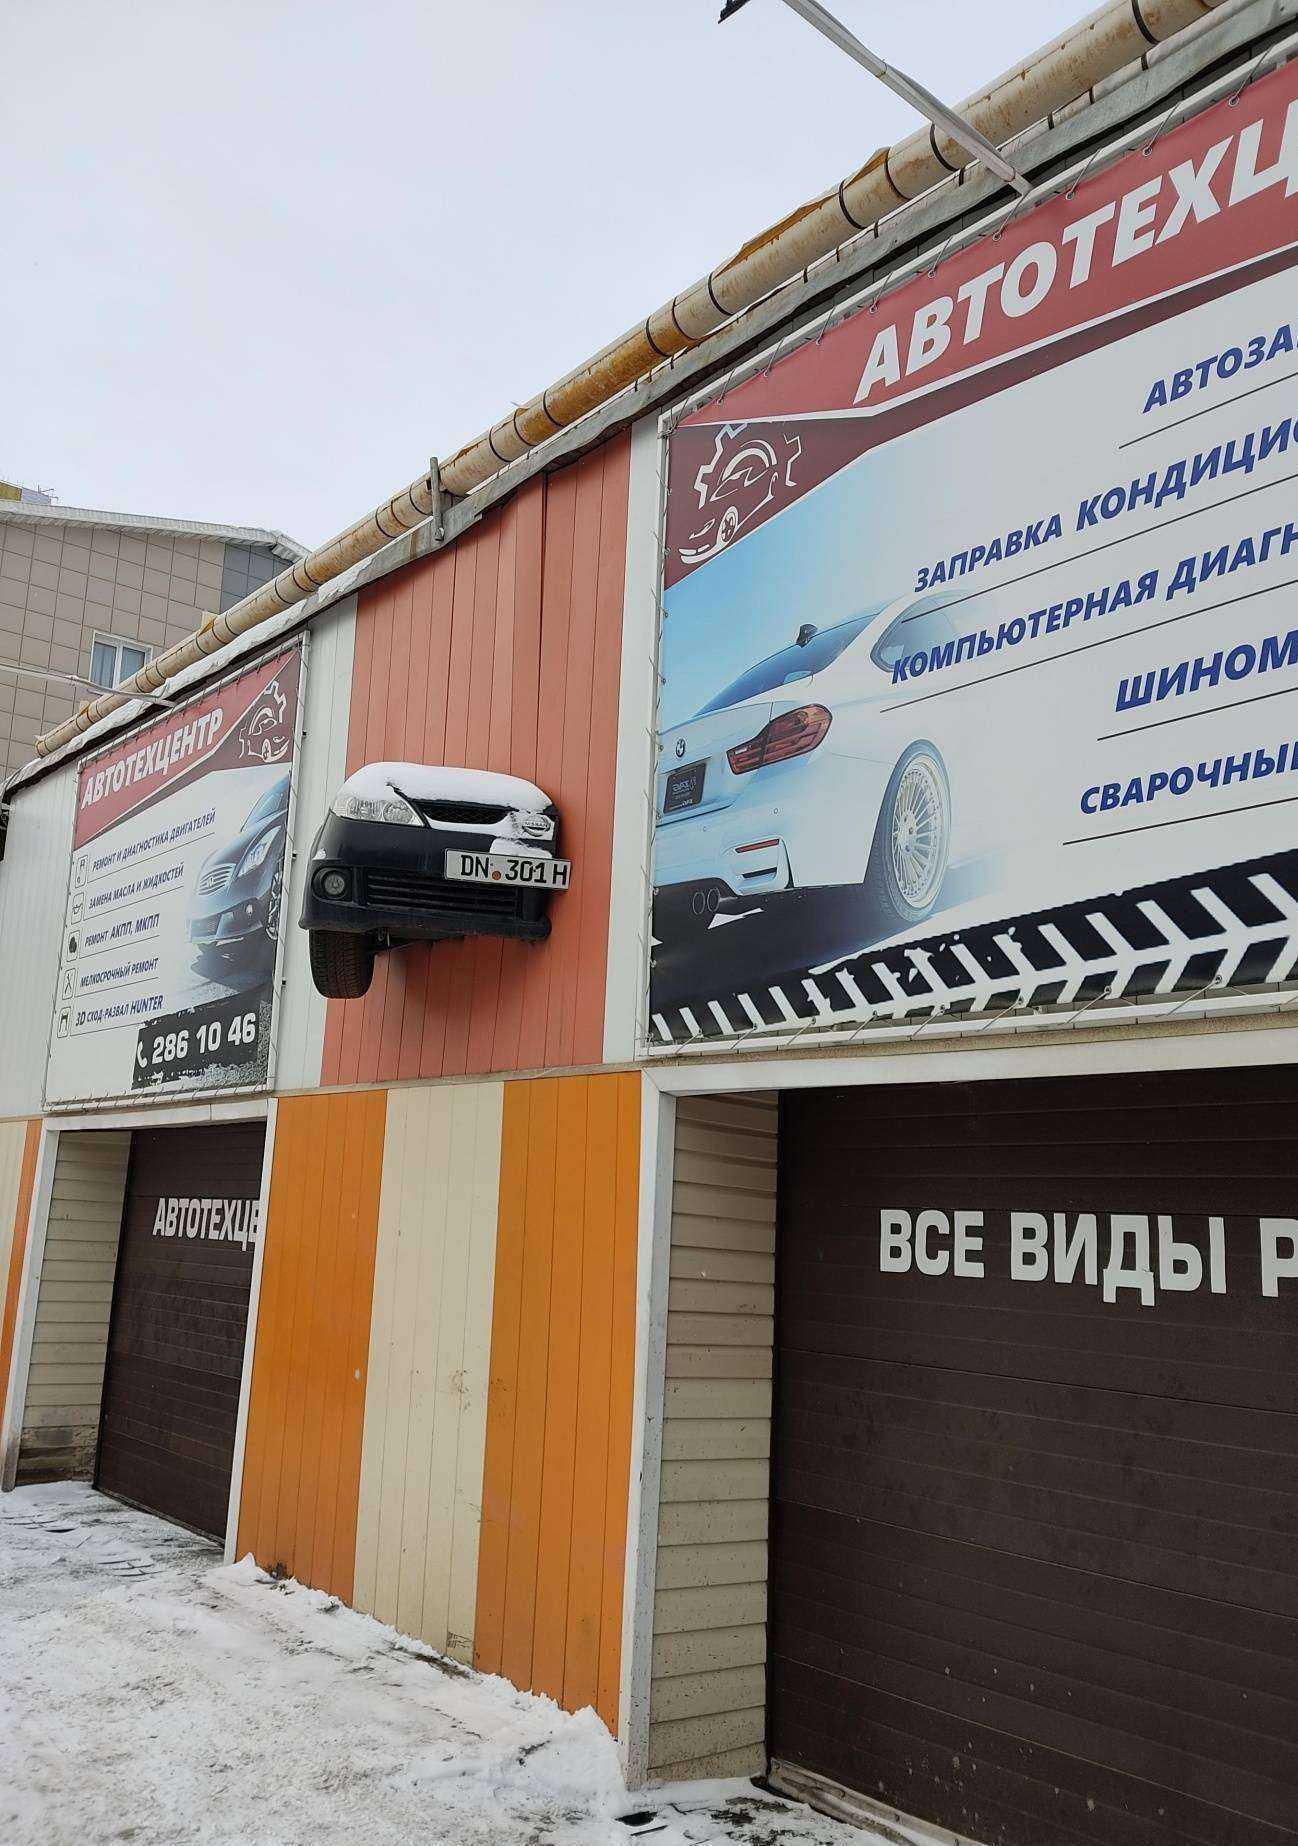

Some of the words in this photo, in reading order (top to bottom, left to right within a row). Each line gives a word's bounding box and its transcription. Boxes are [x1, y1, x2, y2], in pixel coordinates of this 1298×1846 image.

[853, 99, 1298, 405] АВТОТЕХЦ
[1142, 324, 1298, 413] АВТОЗА
[914, 514, 1062, 593] ЗАПРАВКА
[1075, 417, 1298, 531] КОНДИЦИ
[891, 569, 1159, 684] КОМПЬЮТЕРНАЯ
[1115, 630, 1298, 712] ШИНОМ
[80, 708, 223, 810] АВТОТЕХЦЕНТР
[92, 852, 117, 872] РЕМОНТ
[121, 834, 169, 861] ДИАГНОСТИКА
[170, 807, 216, 842] ДВИГАТЕЛЕЙ
[460, 854, 490, 879] DN
[504, 859, 547, 884] 301
[552, 863, 568, 886] H
[88, 893, 112, 910] ЗАМЕНА
[112, 882, 134, 902] МАСЛА
[142, 862, 184, 891] ЖИДКОСТЕЙ
[84, 930, 109, 948] РЕМОНТ
[109, 920, 134, 940] АКПП,
[134, 913, 160, 933] МКПП
[79, 961, 131, 988] МЕЛКОСРОЧНЫЙ
[130, 957, 159, 975] РЕМОНТ
[129, 995, 164, 1016] HUNTER
[151, 1029, 190, 1065] 286
[195, 1021, 222, 1054] 10
[227, 1012, 257, 1046] 46
[879, 1209, 985, 1278] ВСЕ
[1009, 1212, 1227, 1306] ВИДЫ
